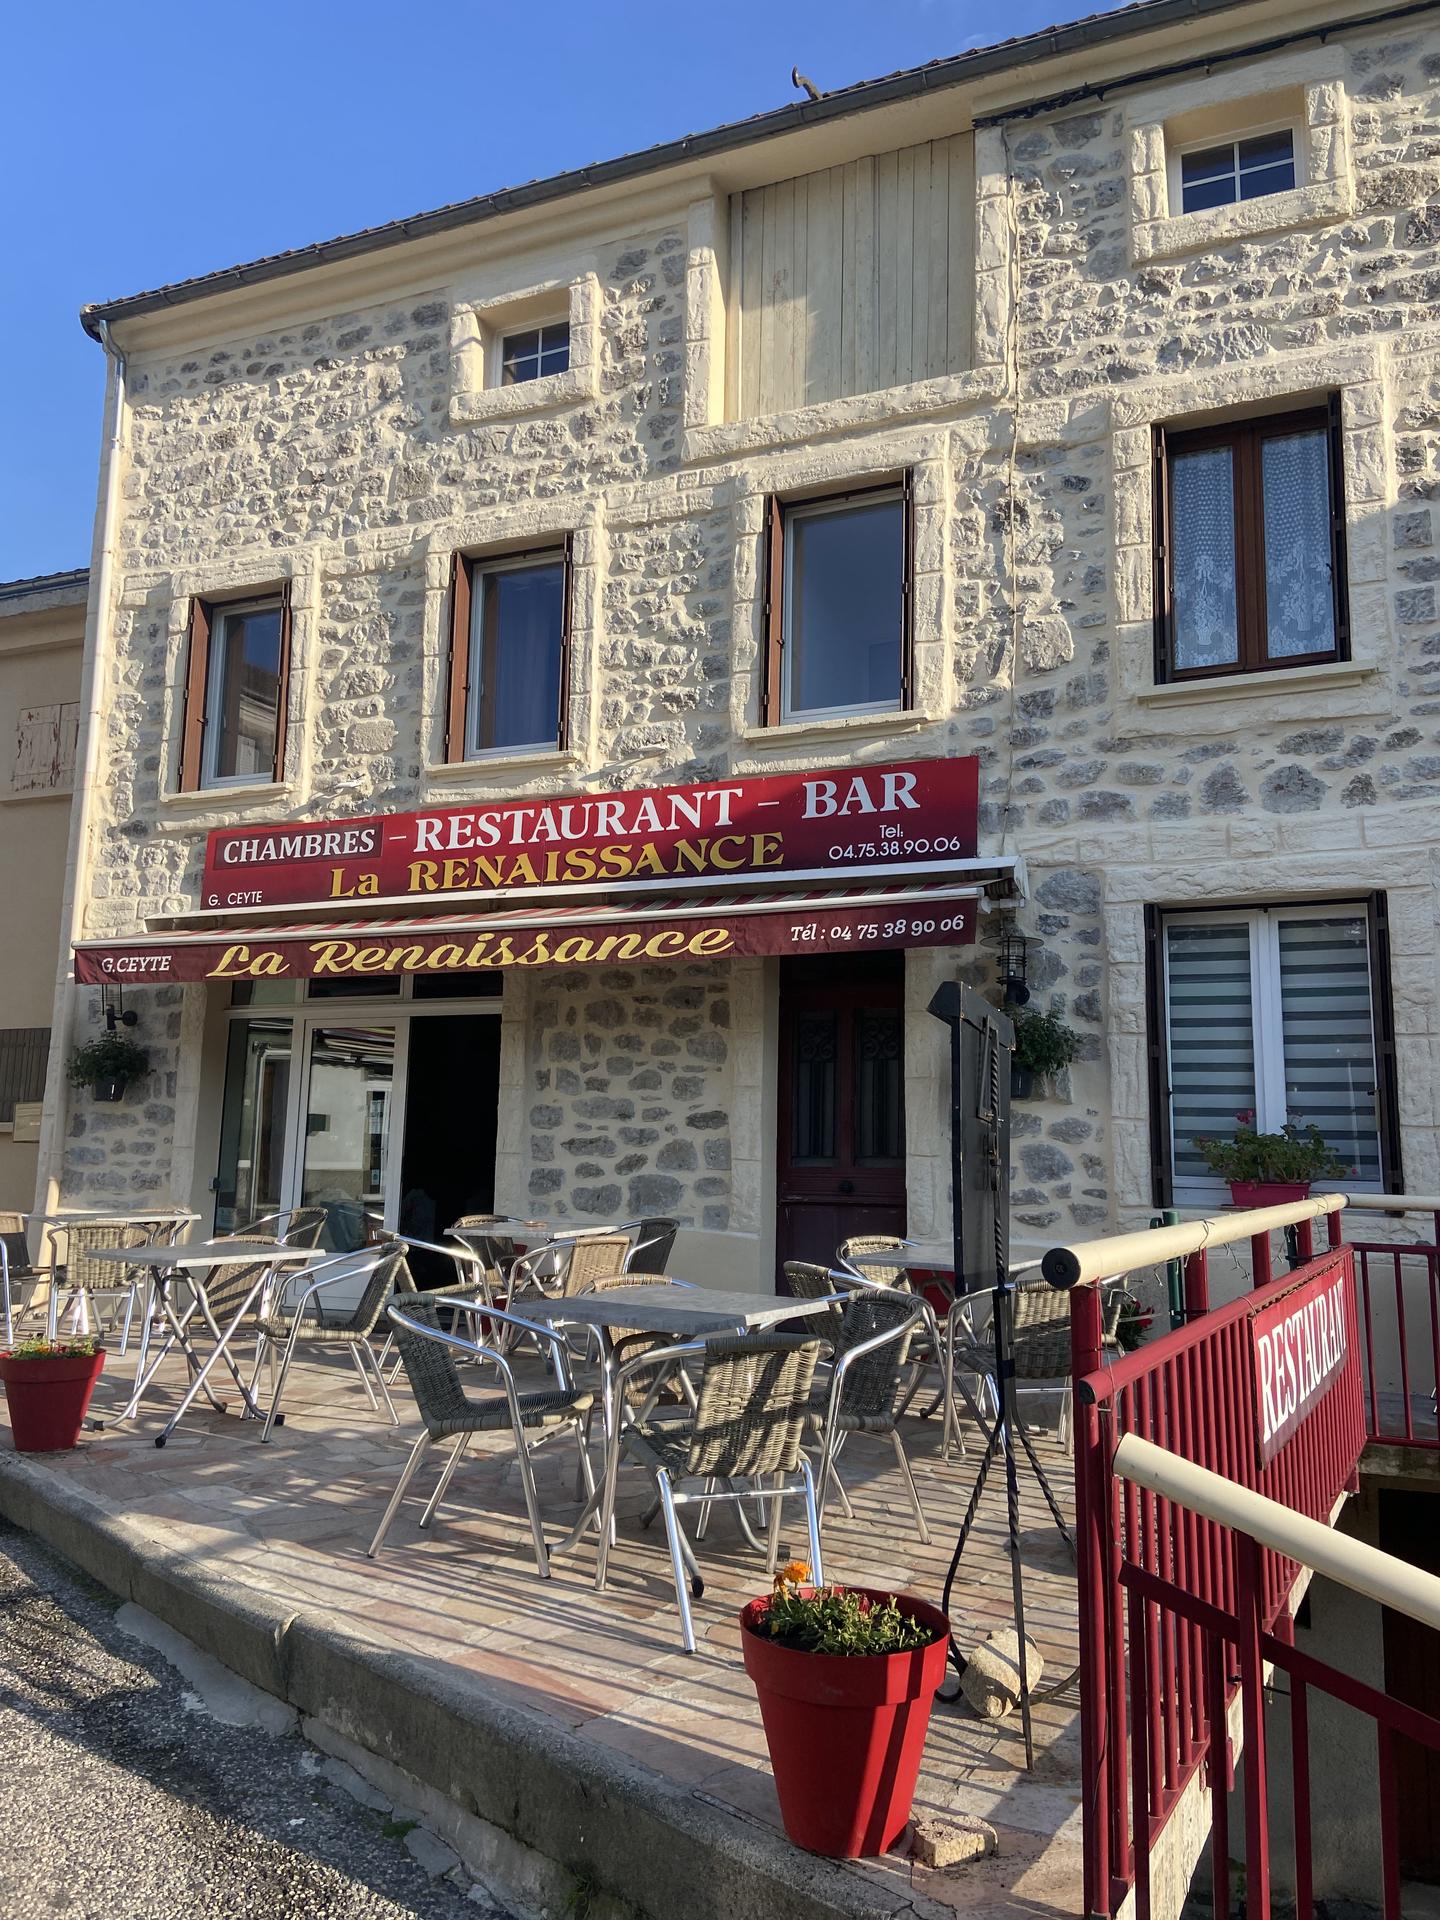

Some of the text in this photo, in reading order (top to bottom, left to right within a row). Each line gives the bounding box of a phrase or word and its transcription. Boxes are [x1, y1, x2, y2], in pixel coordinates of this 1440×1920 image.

[223, 829, 375, 865] CHAMBRES
[413, 788, 743, 853] RESTAURANT
[801, 772, 921, 819] BAR
[879, 824, 904, 838] Tel:
[828, 837, 961, 861] 04.75.38.90.06
[329, 831, 785, 898] La RENAISSANCE
[208, 890, 263, 907] G. CEYTE
[830, 925, 852, 941] 04
[857, 923, 879, 940] 75
[882, 919, 907, 938] 38
[911, 920, 936, 937] 90
[940, 914, 965, 931] 06
[101, 956, 172, 973] G.CEYTE
[206, 928, 735, 977] La Renaissance
[1257, 1276, 1347, 1445] RESTAURANT
